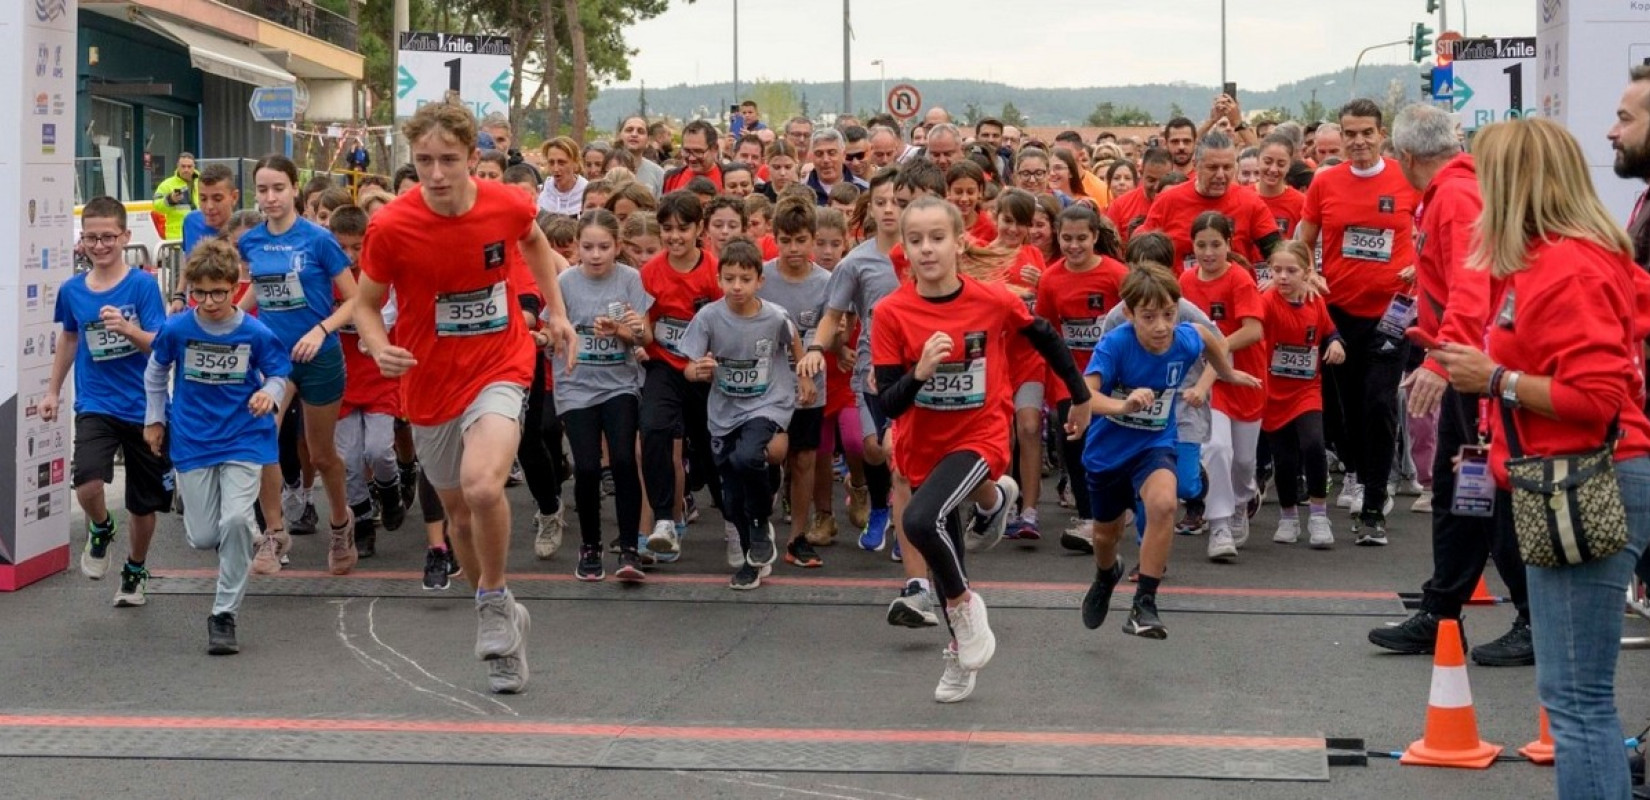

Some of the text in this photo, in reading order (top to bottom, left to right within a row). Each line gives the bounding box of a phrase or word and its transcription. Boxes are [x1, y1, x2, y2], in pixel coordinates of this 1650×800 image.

[1437, 40, 1454, 55] ST
[445, 57, 461, 91] 1
[1503, 62, 1522, 119] 1
[1351, 233, 1385, 249] 3669
[262, 283, 290, 298] 3134
[449, 301, 497, 320] 3536
[1067, 325, 1102, 339] 3440
[584, 337, 618, 351] 3104
[194, 352, 239, 370] 3549
[1280, 352, 1312, 367] 3435
[724, 369, 758, 383] 3019
[924, 374, 974, 393] 3343
